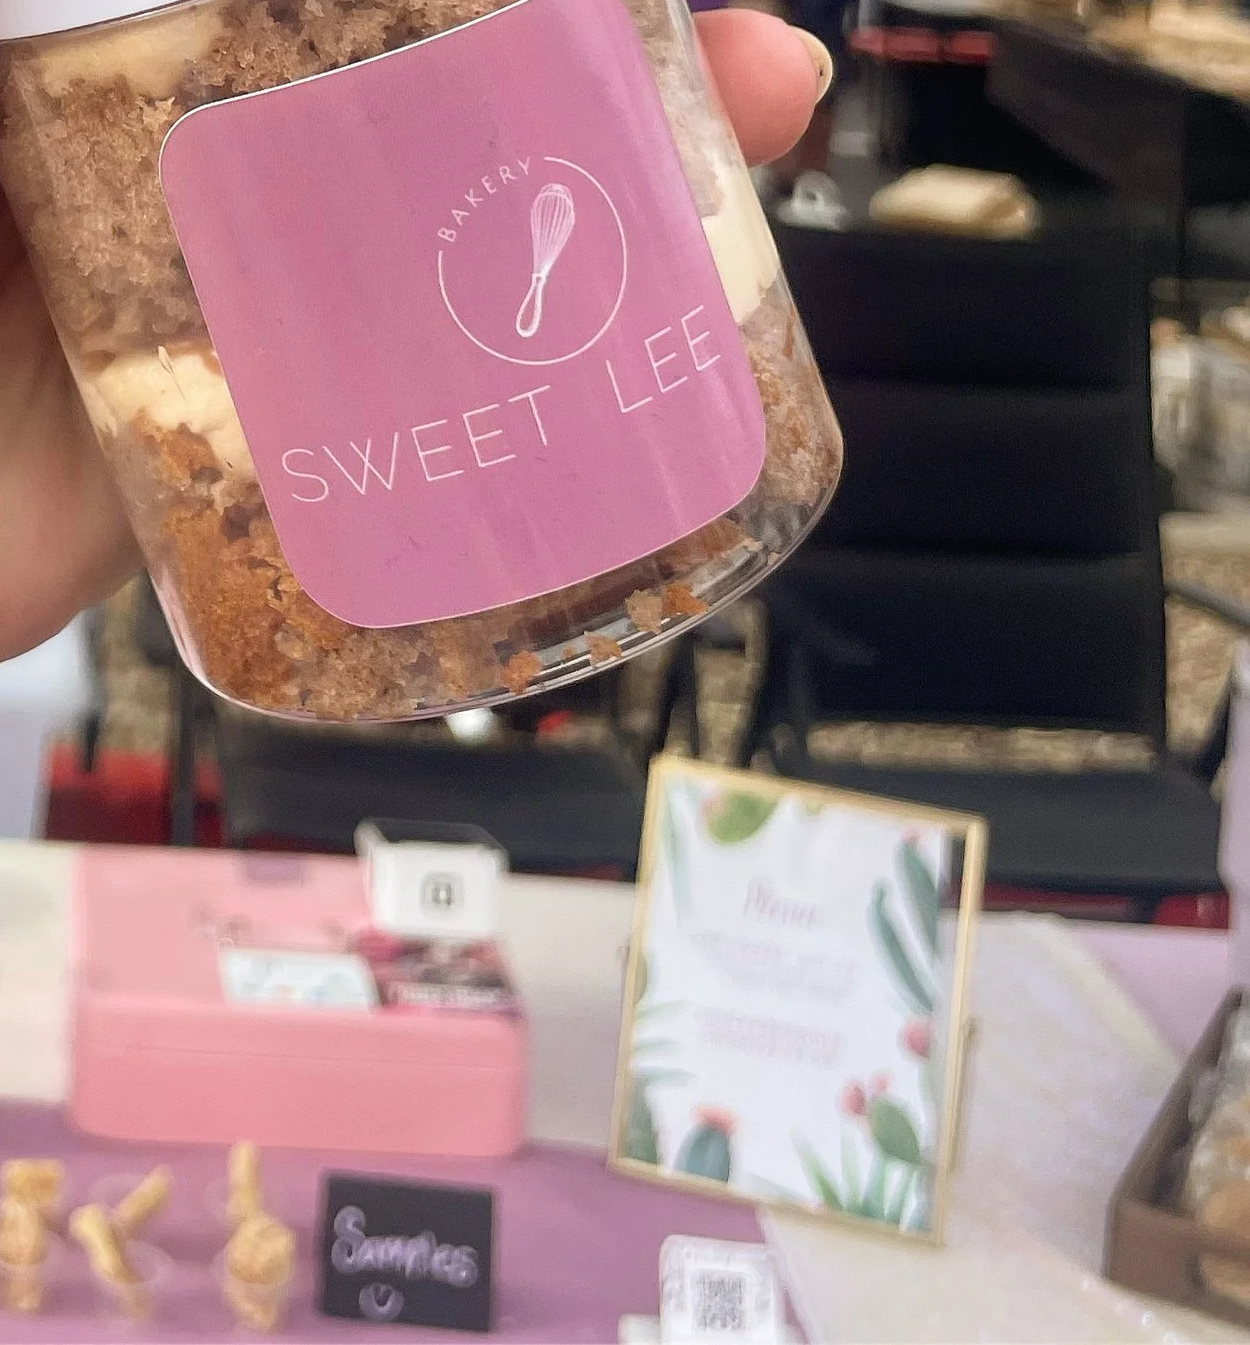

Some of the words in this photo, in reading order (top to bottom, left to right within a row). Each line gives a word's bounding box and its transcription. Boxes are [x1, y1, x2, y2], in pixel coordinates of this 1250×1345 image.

[437, 156, 533, 243] BAKERY
[281, 385, 551, 503] SWEET
[606, 304, 722, 414] LEE
